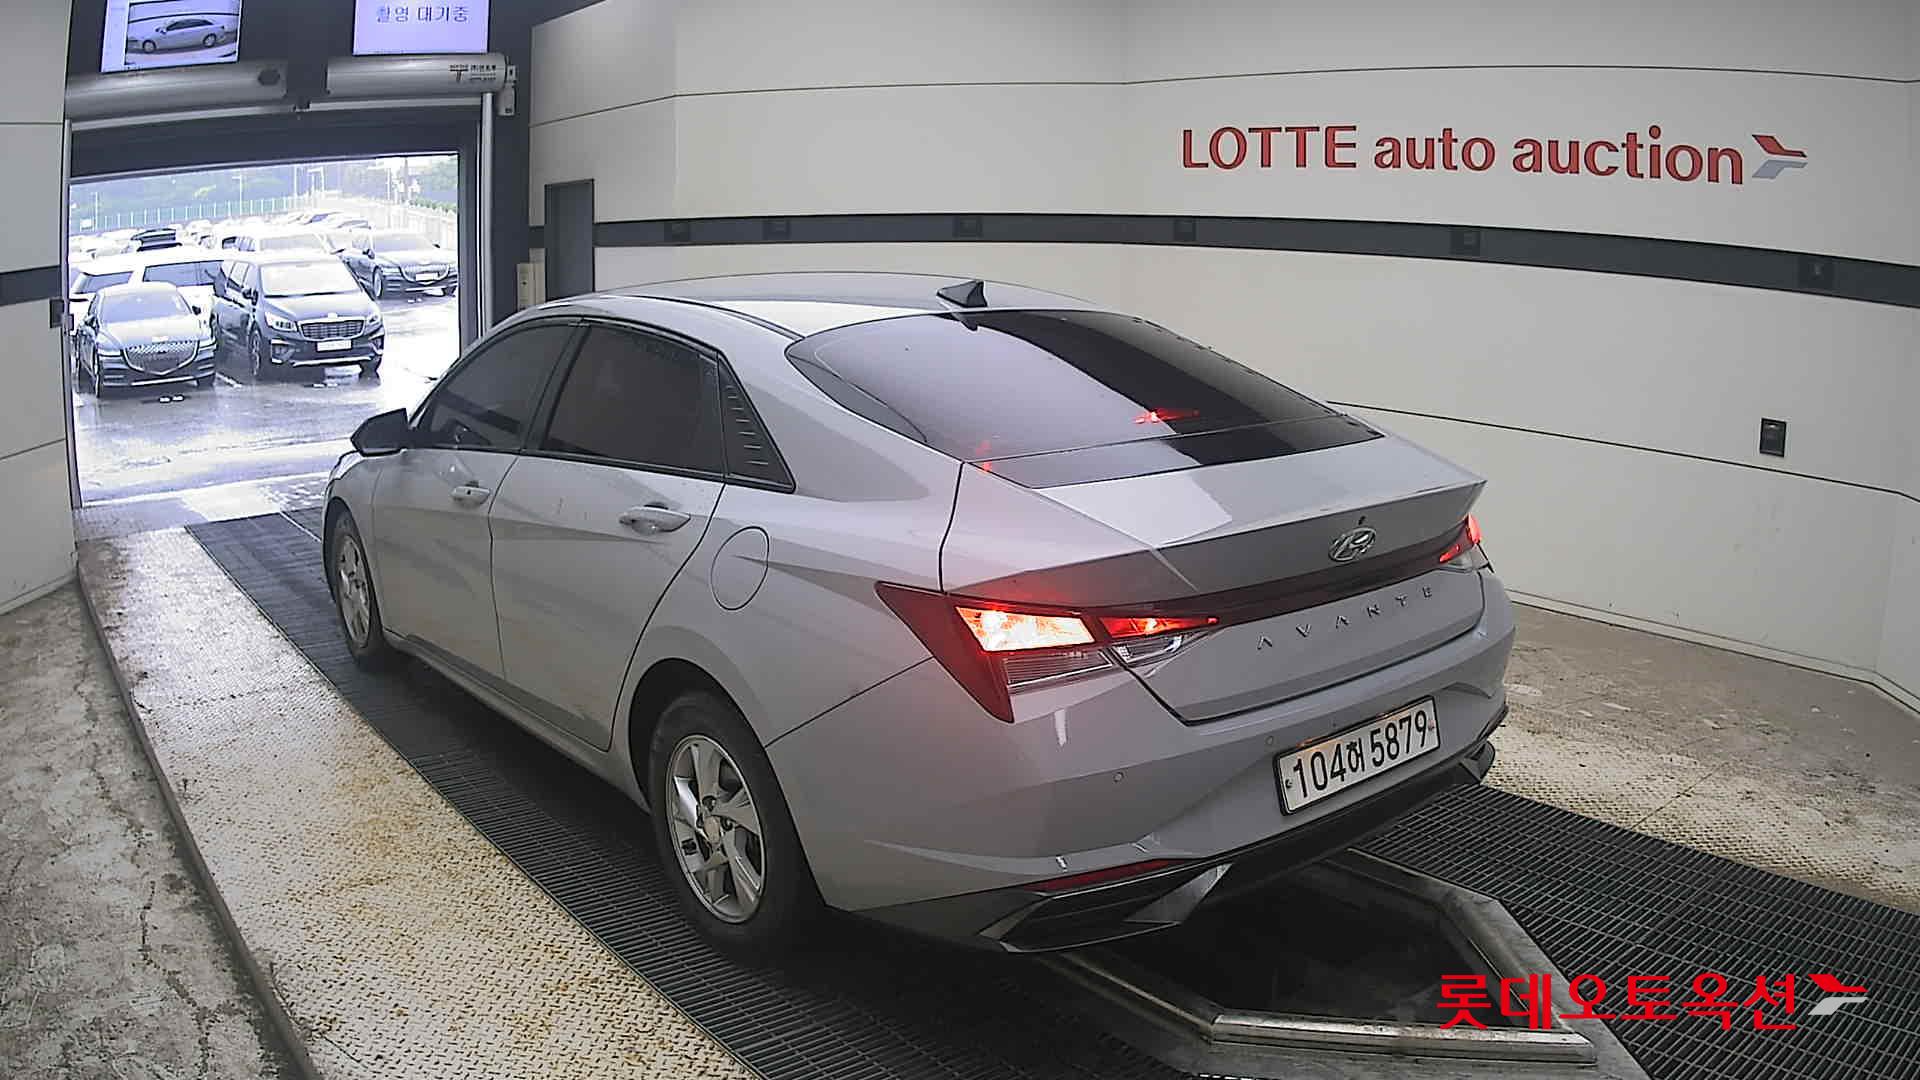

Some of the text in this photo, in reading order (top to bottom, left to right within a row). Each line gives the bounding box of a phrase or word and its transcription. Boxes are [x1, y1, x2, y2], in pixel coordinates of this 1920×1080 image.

[417, 6, 470, 23] 대기중
[1182, 124, 1744, 185] LOTTE auto auction
[1256, 585, 1433, 651] AVANTE
